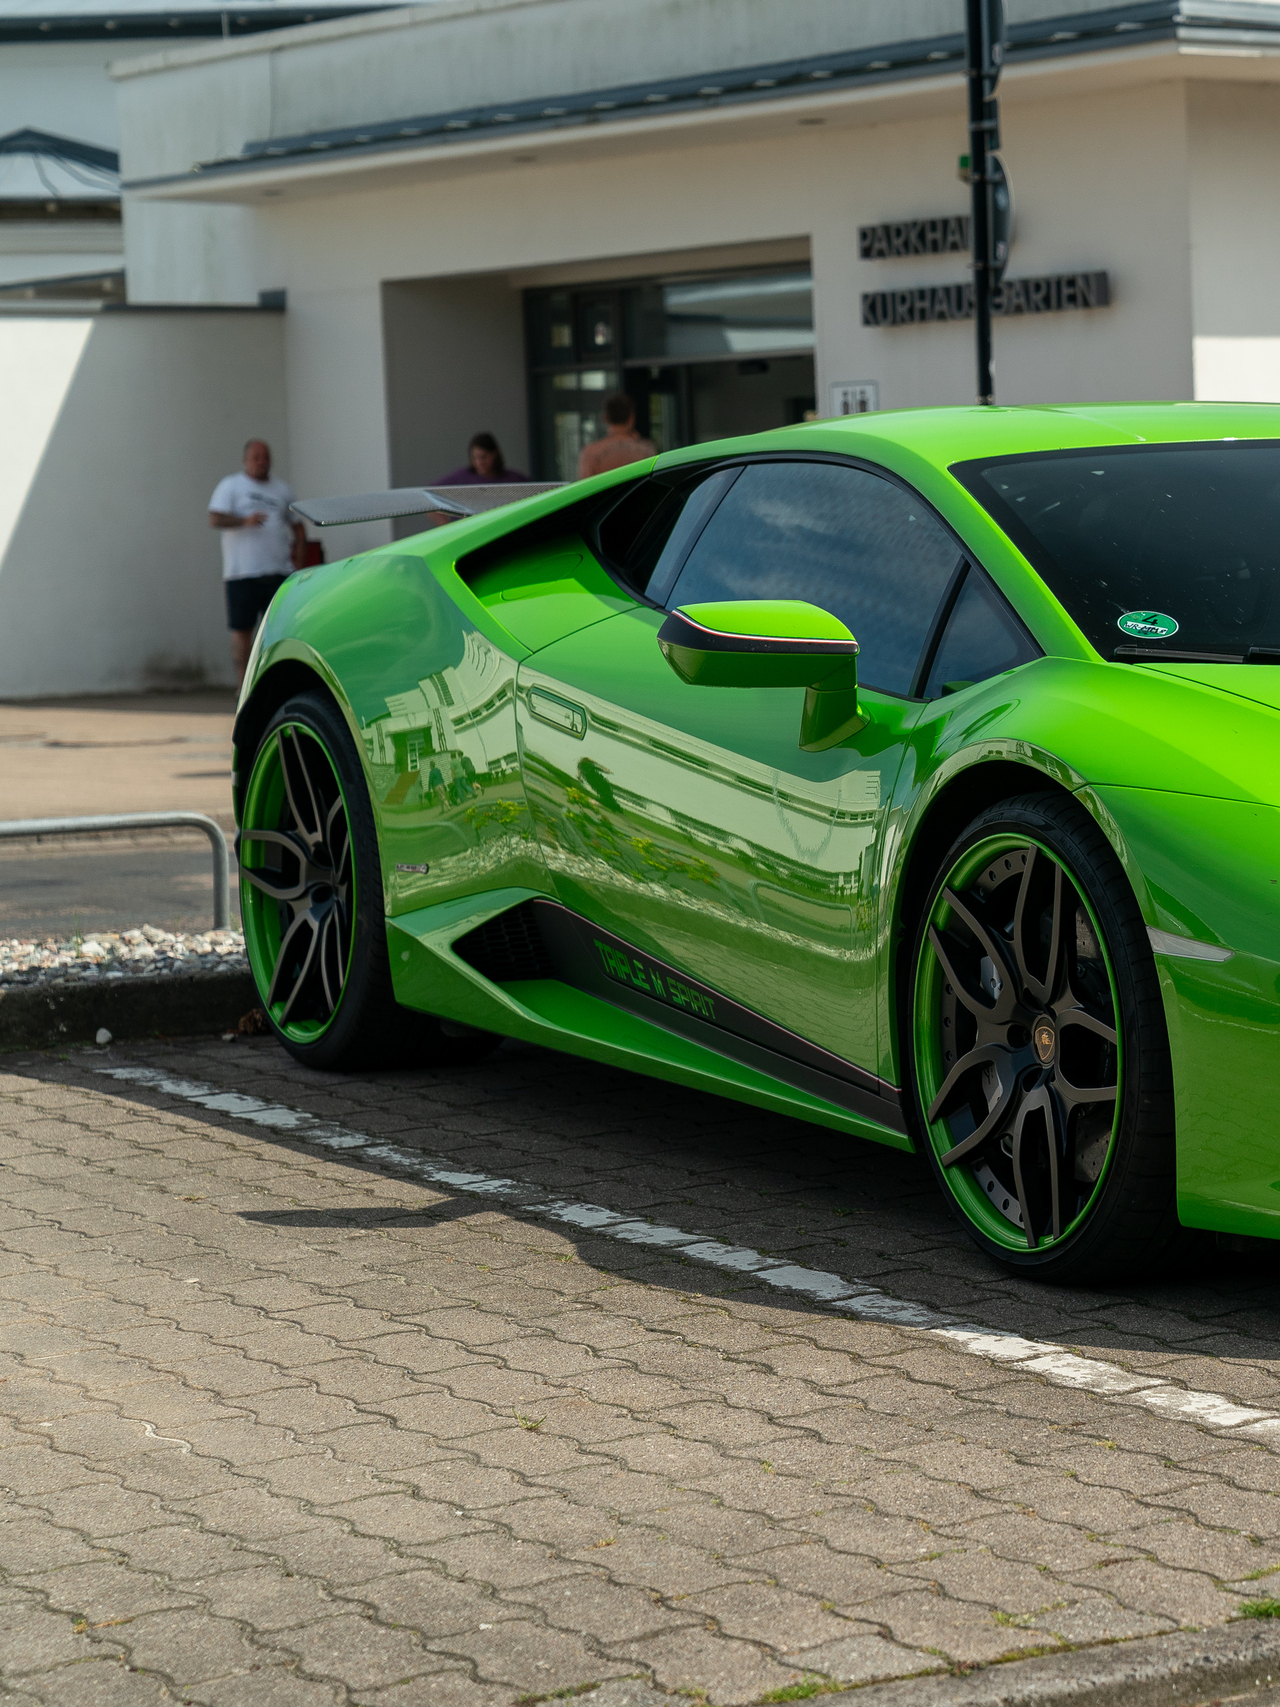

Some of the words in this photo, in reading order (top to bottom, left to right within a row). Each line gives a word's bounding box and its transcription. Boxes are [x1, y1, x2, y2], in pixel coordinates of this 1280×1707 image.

[859, 216, 971, 260] PARKHA
[593, 939, 651, 990] TRIPLE
[666, 976, 716, 1020] SPIRIT
